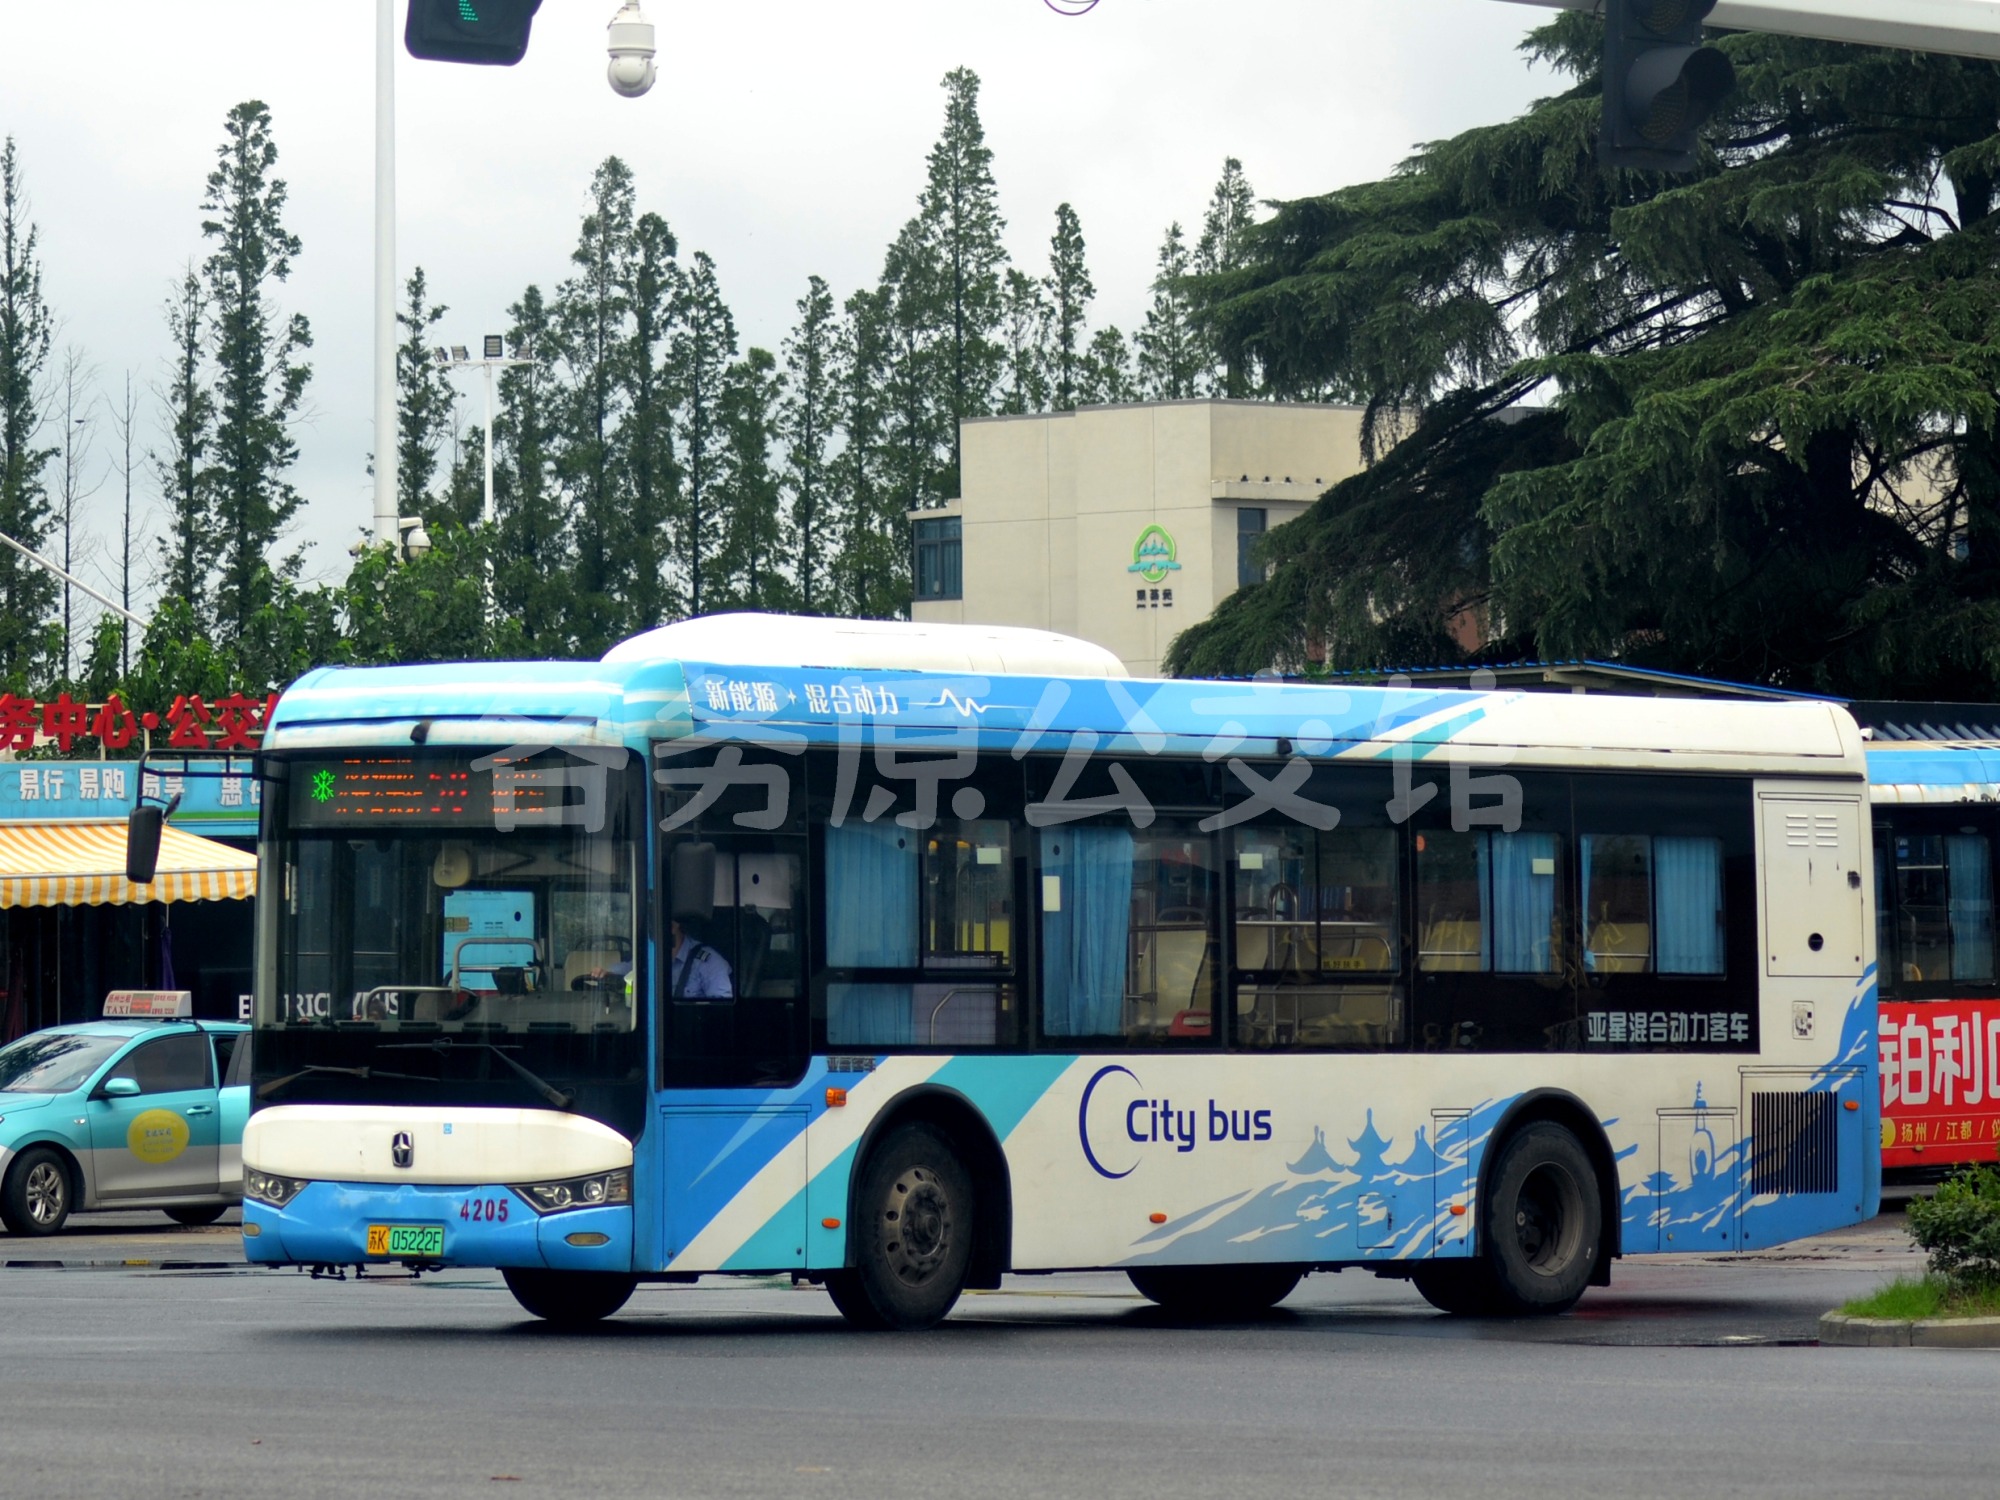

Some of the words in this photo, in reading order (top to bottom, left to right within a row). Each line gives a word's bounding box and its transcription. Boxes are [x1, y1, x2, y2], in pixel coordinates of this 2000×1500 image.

[704, 680, 778, 712] 新能源
[804, 683, 899, 715] 混合动力
[0, 692, 281, 750] 务中心·公交
[19, 769, 64, 800] 易行
[79, 768, 125, 799] 易购
[106, 1005, 129, 1015] TAXI
[1588, 1012, 1748, 1042] 亚星混合动力客车
[1879, 1011, 2000, 1108] 铂利
[1127, 1099, 1195, 1152] City
[1209, 1099, 1272, 1141] bus
[1901, 1122, 1927, 1142] 扬州
[1946, 1120, 1972, 1140] 江都
[460, 1199, 509, 1222] 4205
